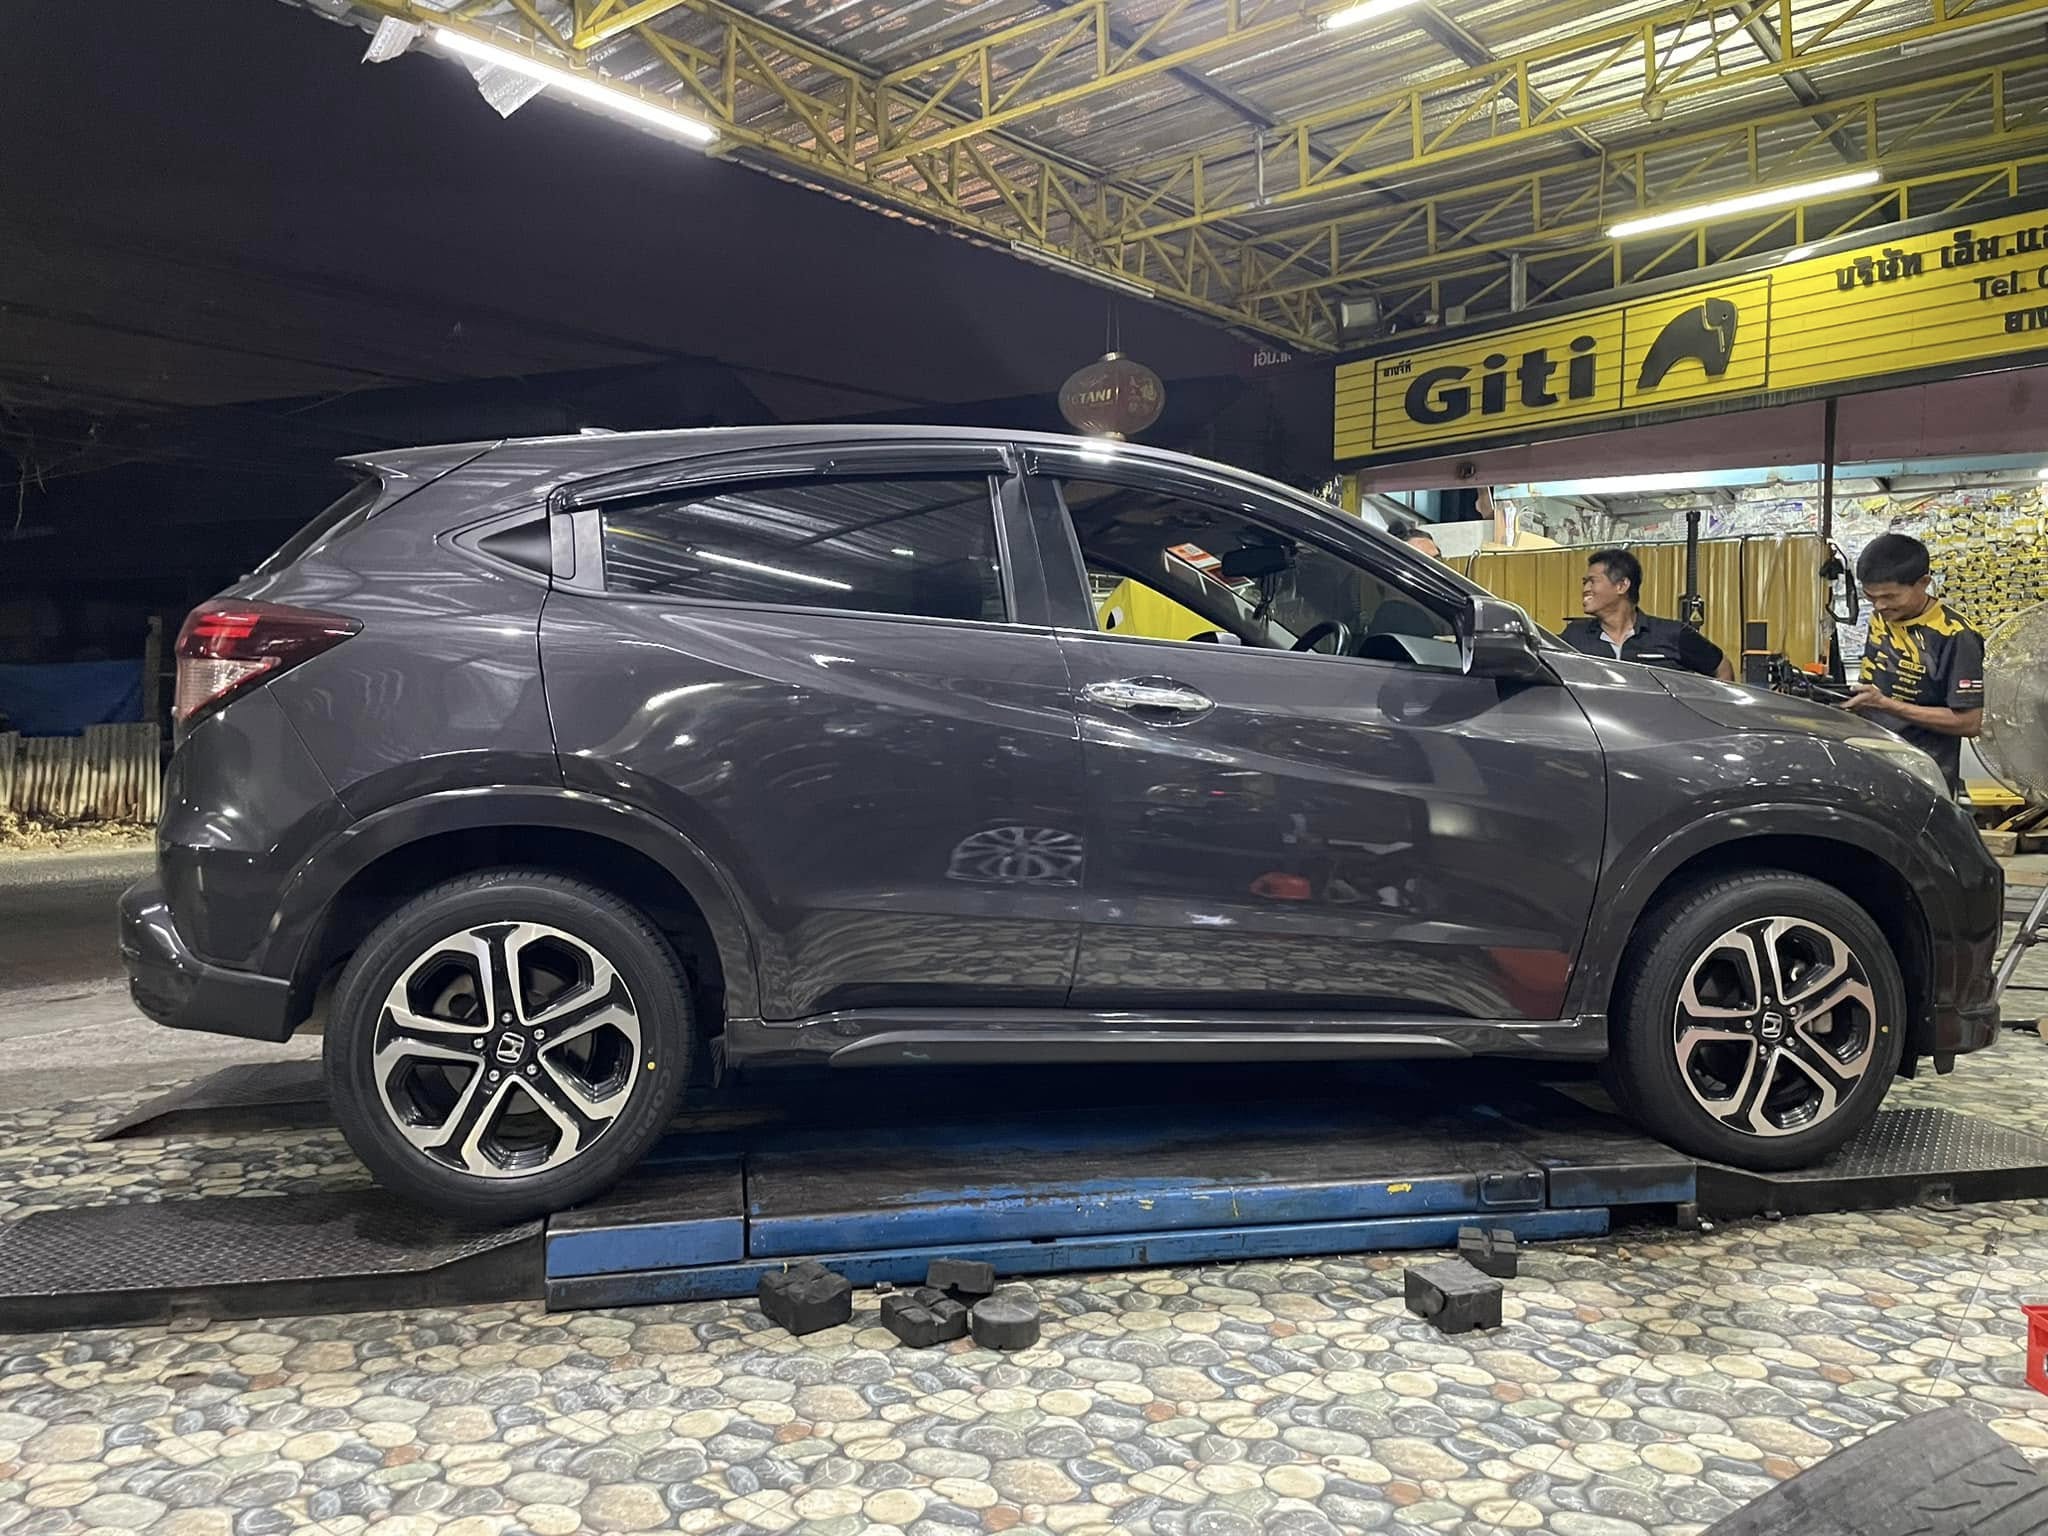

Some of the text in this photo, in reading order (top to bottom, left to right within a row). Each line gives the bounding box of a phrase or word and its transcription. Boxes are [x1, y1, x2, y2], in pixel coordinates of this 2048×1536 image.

[1836, 248, 1923, 291] บริษัท
[1974, 270, 2027, 300] Tel.
[1404, 335, 1597, 424] Giti
